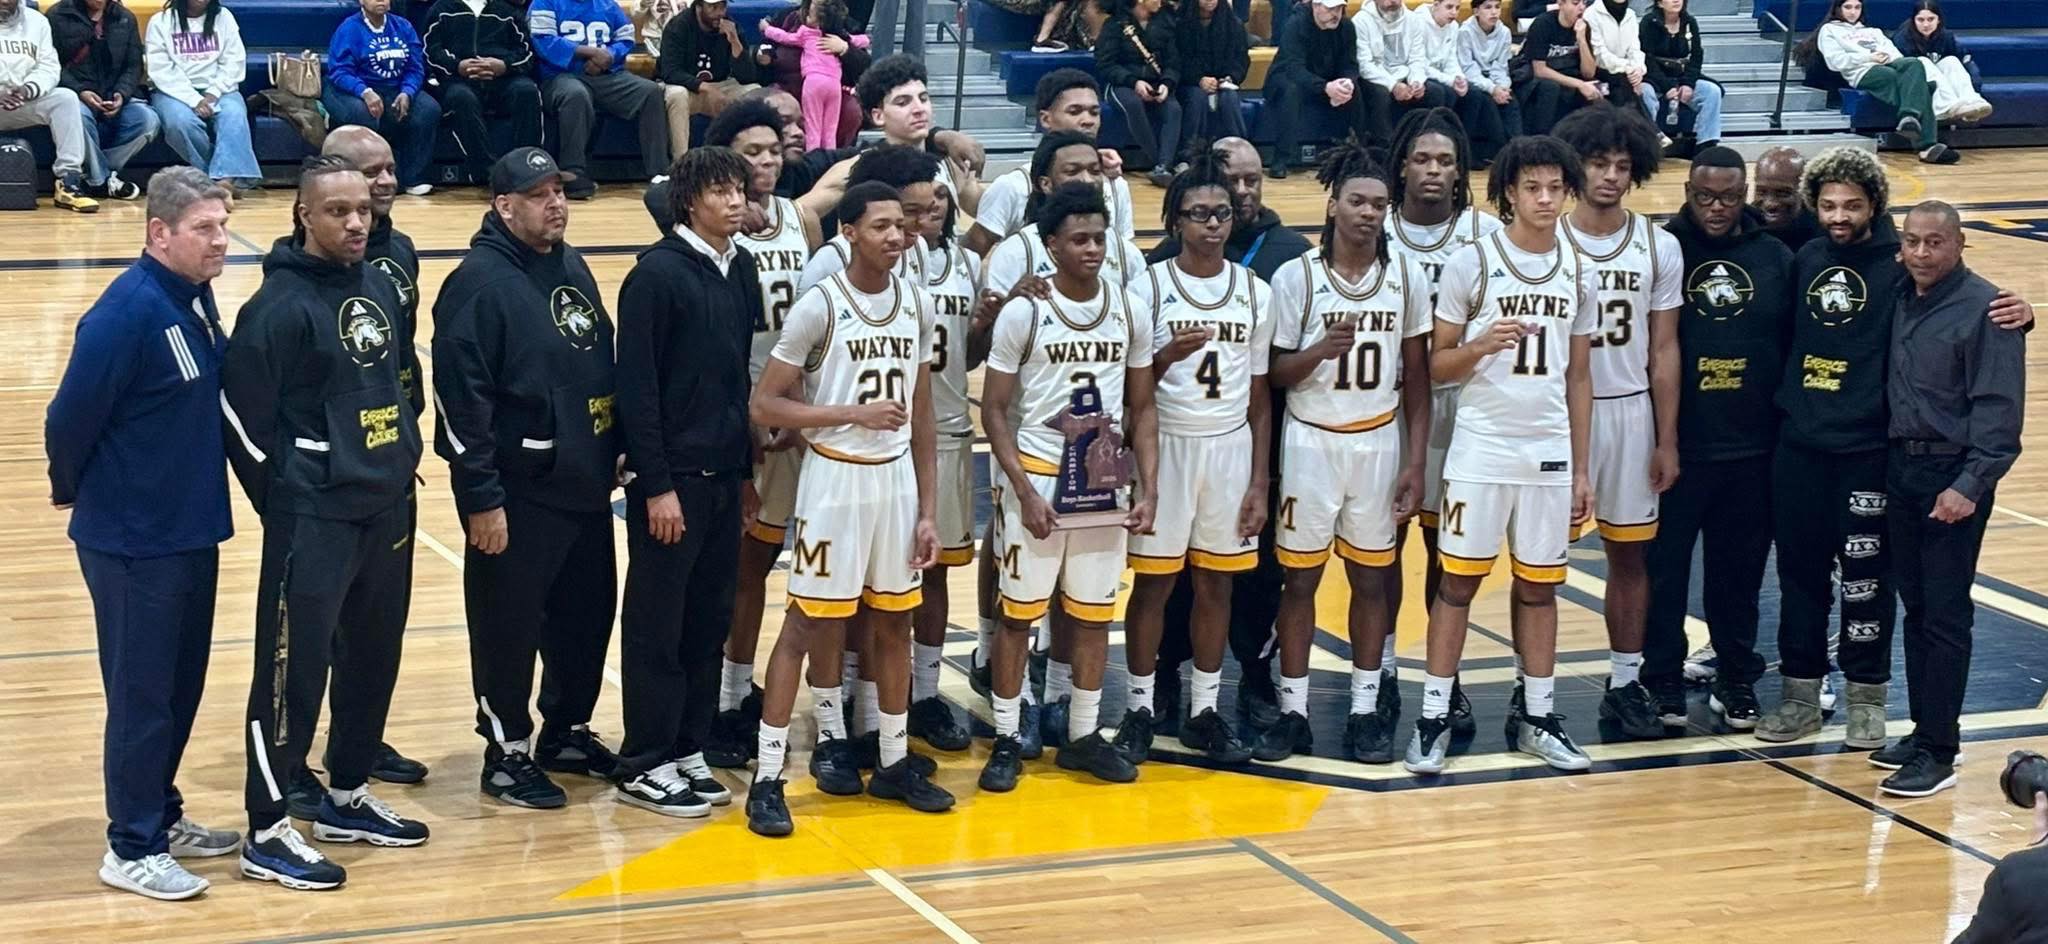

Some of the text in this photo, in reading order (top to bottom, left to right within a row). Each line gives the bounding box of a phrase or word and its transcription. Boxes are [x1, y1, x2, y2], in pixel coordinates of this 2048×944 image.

[0, 40, 38, 61] IGAN
[754, 250, 803, 272] AYNE
[1597, 270, 1641, 292] YNE
[931, 294, 970, 317] YNE
[1497, 294, 1569, 319] WAYNE
[1321, 311, 1397, 332] WYNE
[846, 336, 913, 361] WAYNE
[1044, 341, 1124, 364] WAYNE
[1513, 325, 1548, 375] 11
[1196, 350, 1221, 399] 4
[1334, 342, 1381, 390] 10
[858, 368, 907, 406] 20
